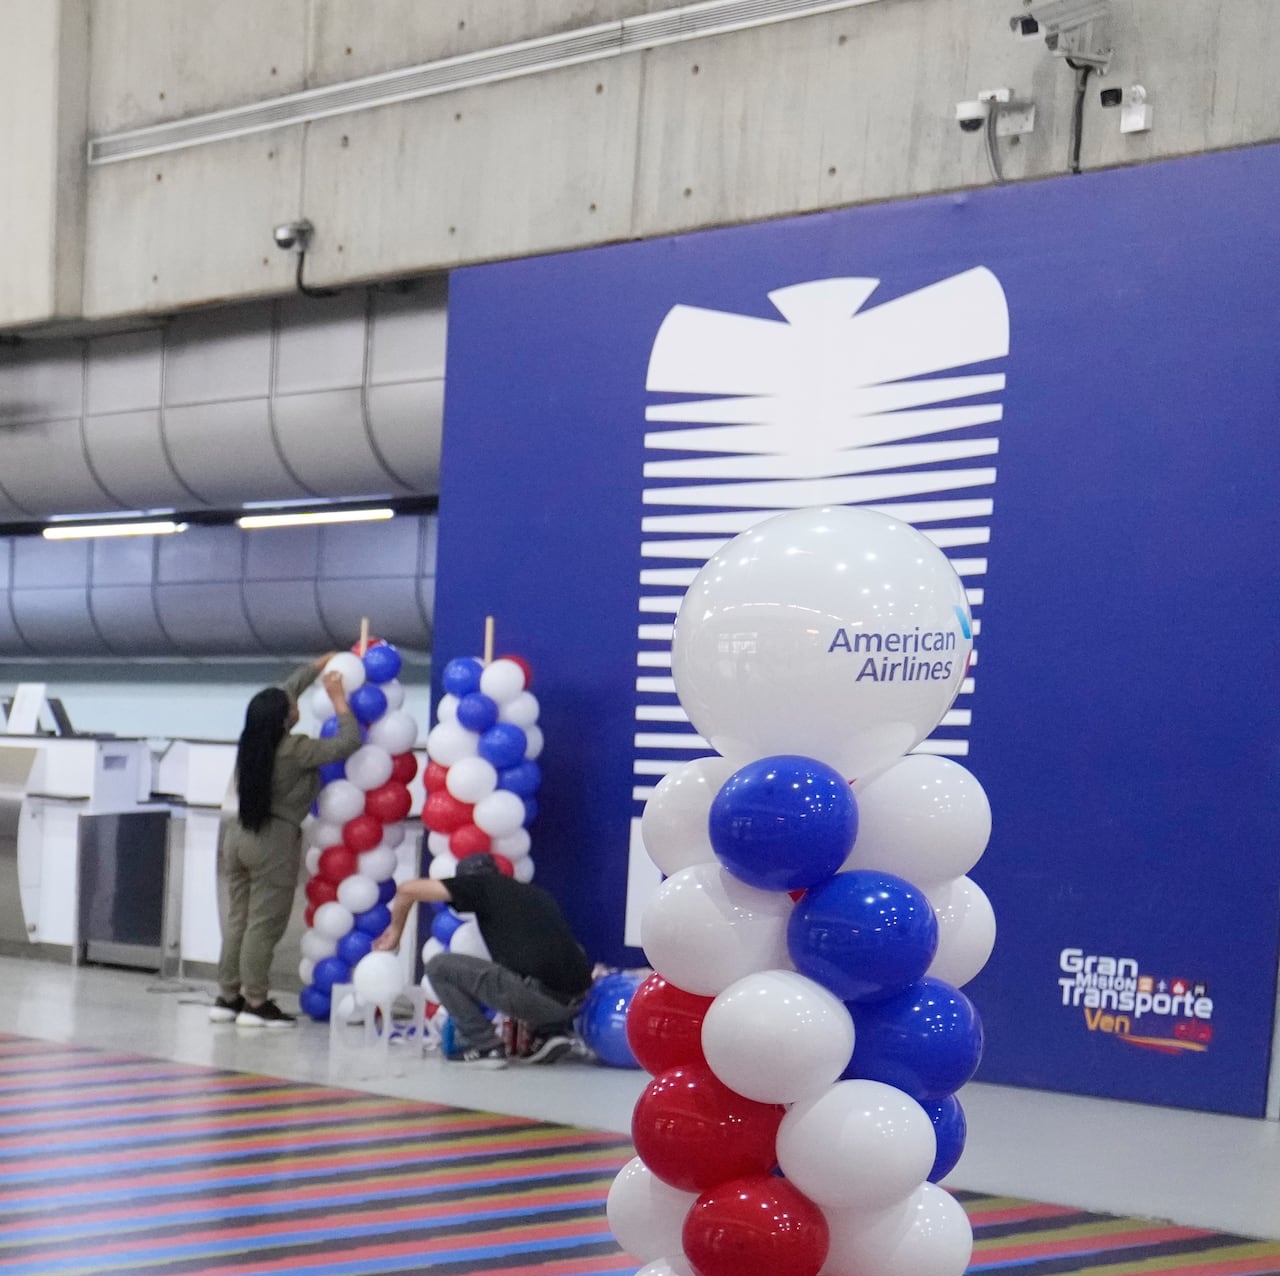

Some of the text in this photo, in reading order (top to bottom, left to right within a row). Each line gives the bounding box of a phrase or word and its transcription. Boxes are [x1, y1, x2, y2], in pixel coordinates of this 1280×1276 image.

[827, 626, 956, 653] American
[855, 656, 953, 682] Airlines
[1059, 947, 1139, 977] Gran
[1057, 977, 1214, 1019] Transporte
